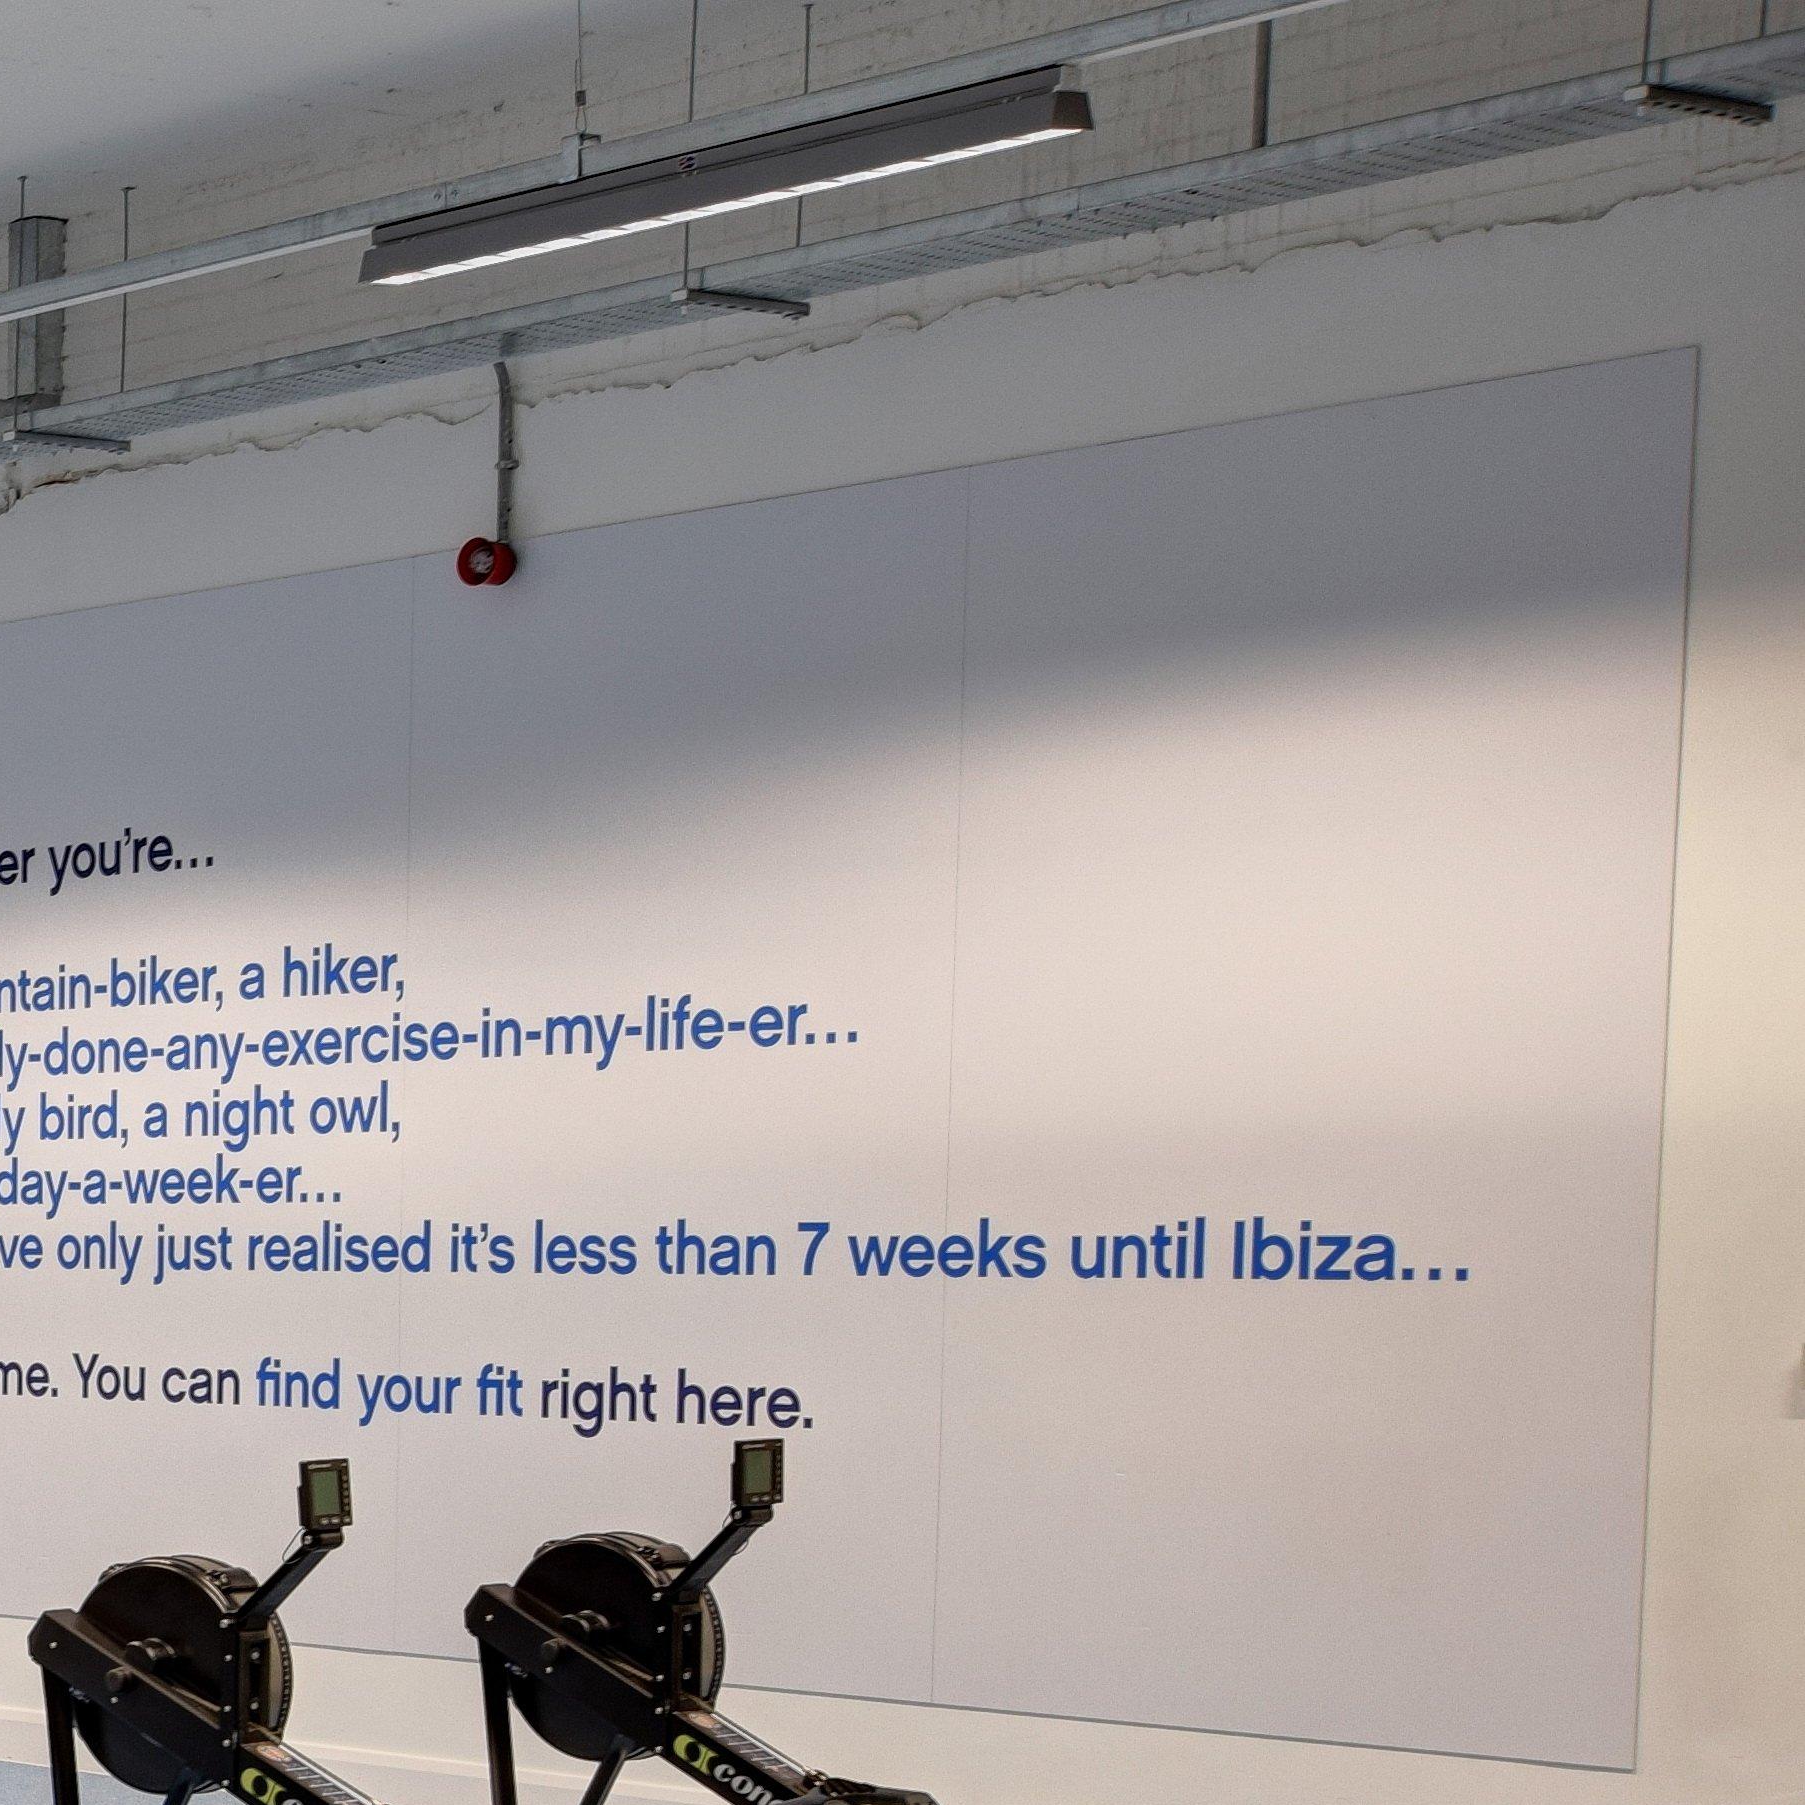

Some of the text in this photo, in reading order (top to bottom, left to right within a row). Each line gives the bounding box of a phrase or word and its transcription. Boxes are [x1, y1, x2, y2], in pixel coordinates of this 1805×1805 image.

[47, 826, 214, 897] you're...
[239, 962, 265, 1000] a
[283, 942, 404, 1002] hiker,
[40, 1089, 128, 1148] bird,
[143, 1102, 168, 1138] a
[185, 1084, 295, 1153] night
[309, 1079, 400, 1143] owl,
[57, 1220, 143, 1286] only
[153, 1223, 233, 1285] just
[248, 1219, 432, 1273] realised
[450, 1222, 515, 1274] it's
[534, 1219, 637, 1275] less
[655, 1218, 776, 1276] than
[797, 1221, 830, 1276] 7
[847, 1217, 1047, 1279] weeks
[1071, 1216, 1206, 1280] until
[1232, 1216, 1468, 1282] Ibiza...
[72, 1352, 146, 1402] You
[161, 1367, 240, 1405] can
[255, 1356, 340, 1410] find
[357, 1374, 462, 1427] your
[476, 1363, 523, 1417] fit
[541, 1365, 658, 1439] right
[676, 1367, 813, 1429] here.
